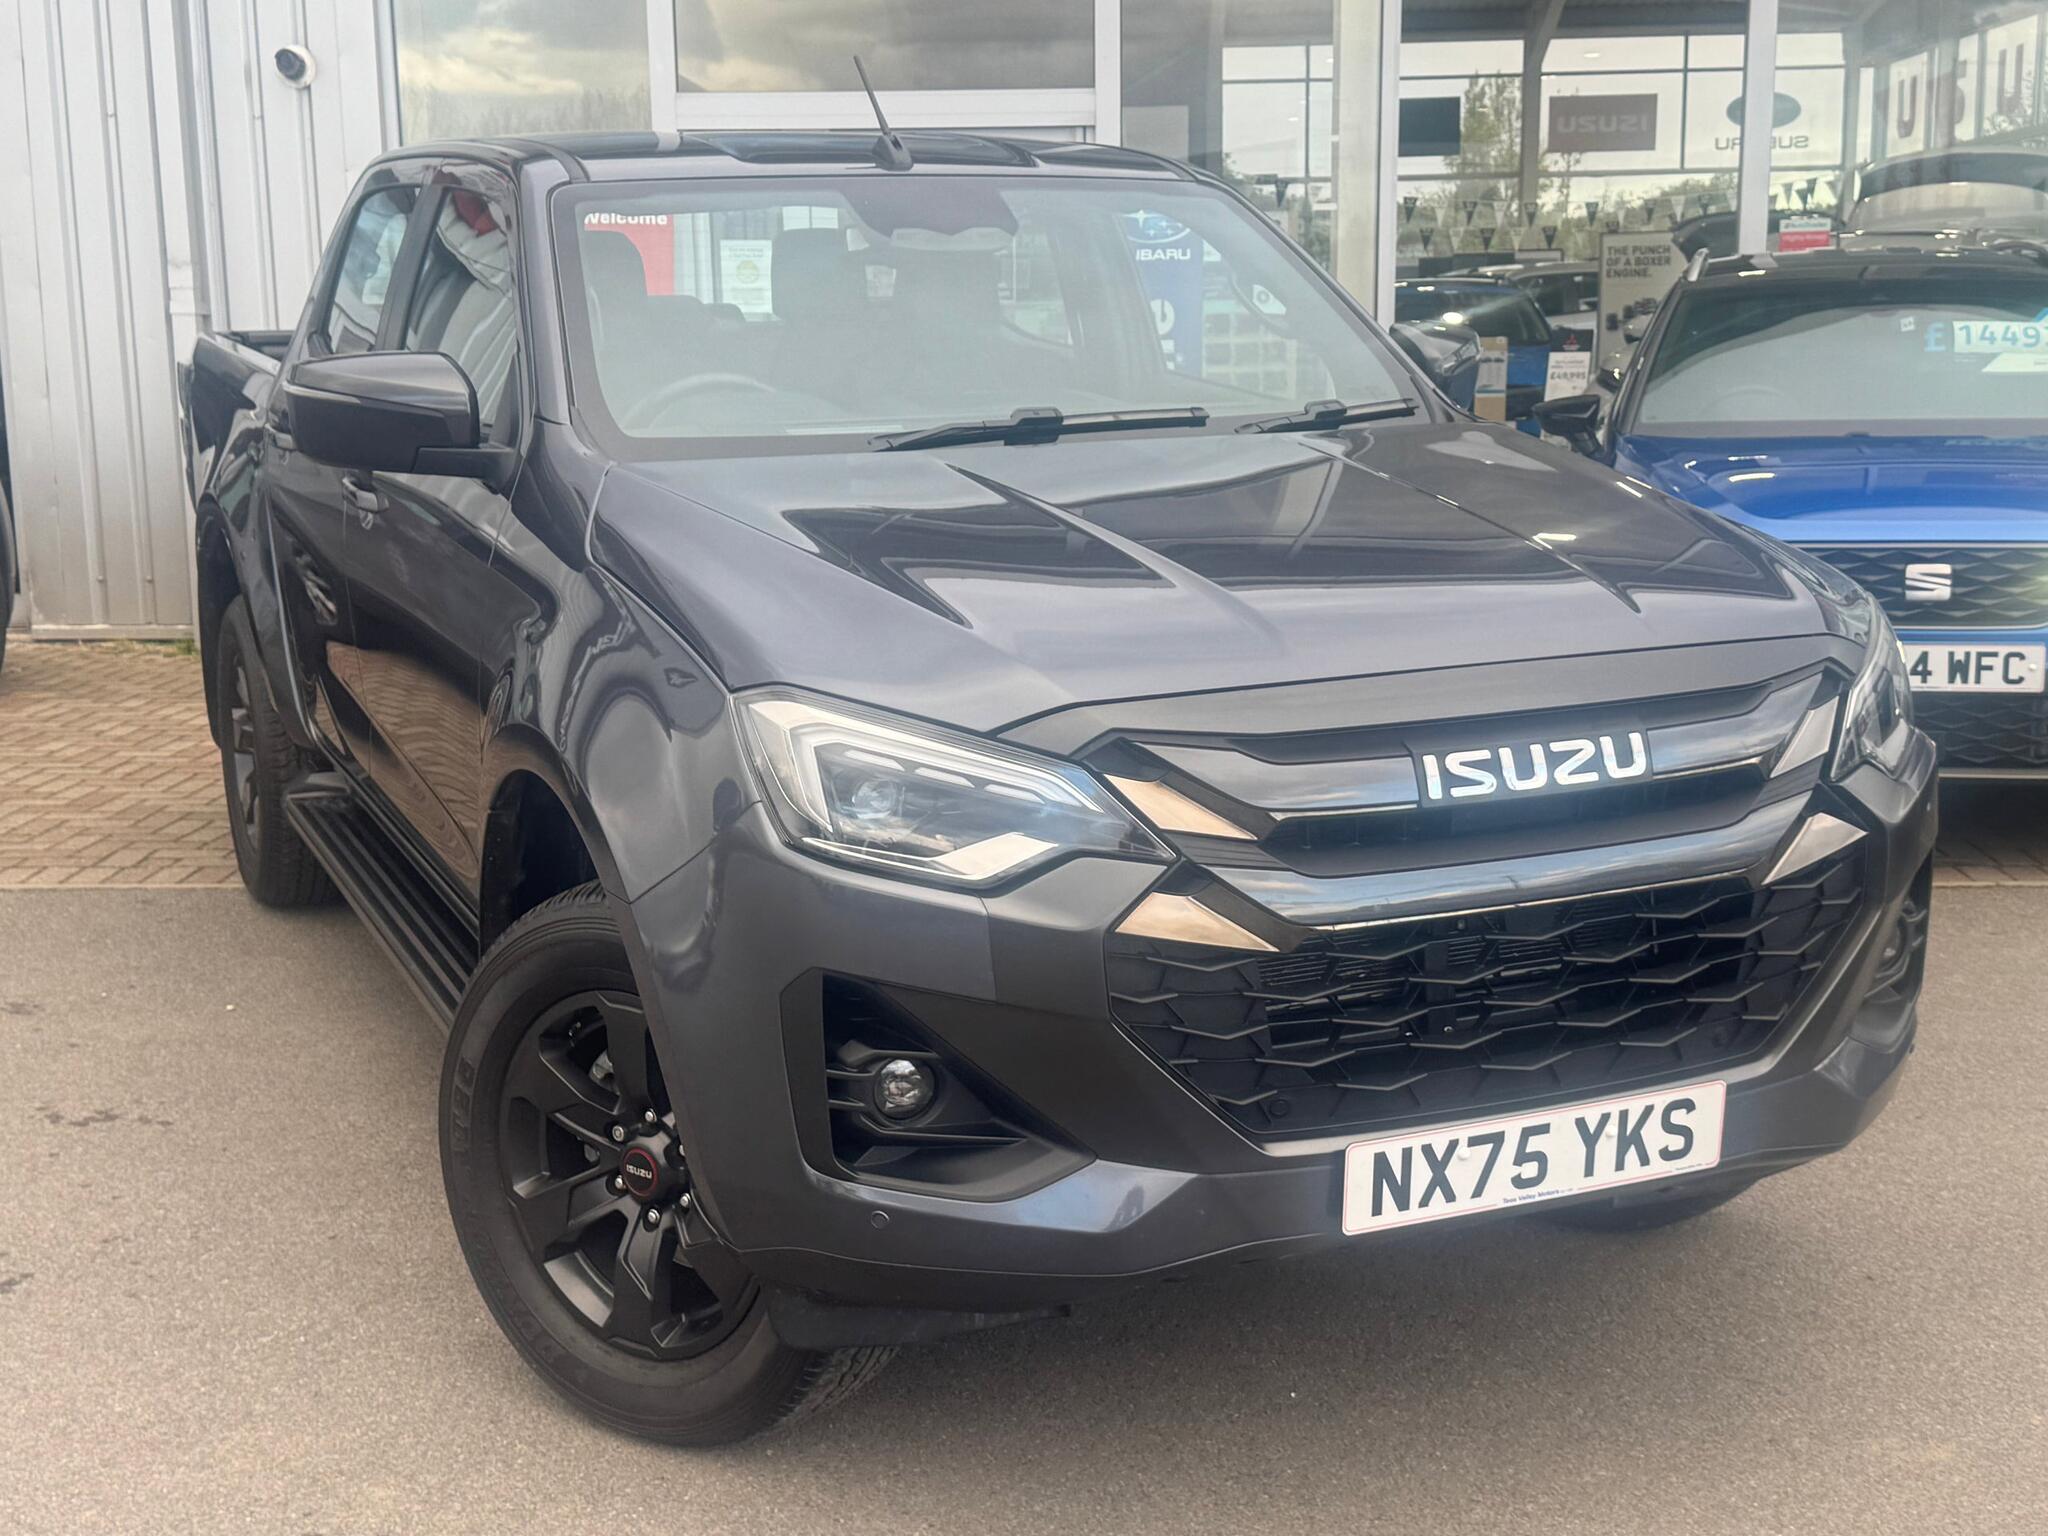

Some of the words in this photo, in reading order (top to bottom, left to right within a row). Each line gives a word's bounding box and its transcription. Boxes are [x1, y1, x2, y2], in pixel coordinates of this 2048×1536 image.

[1606, 257, 1620, 266] OF
[1624, 257, 1632, 266] A
[1634, 256, 1671, 266] BOXER
[1607, 246, 1629, 256] THE
[1632, 245, 1671, 255] PUNCH
[1958, 324, 2048, 348] 1449
[1947, 650, 2027, 686] WFC
[1422, 732, 1647, 800] ISUZU
[1371, 1123, 1551, 1217] NX75
[1574, 1097, 1697, 1178] YKS
[626, 1163, 653, 1179] ISUZU
